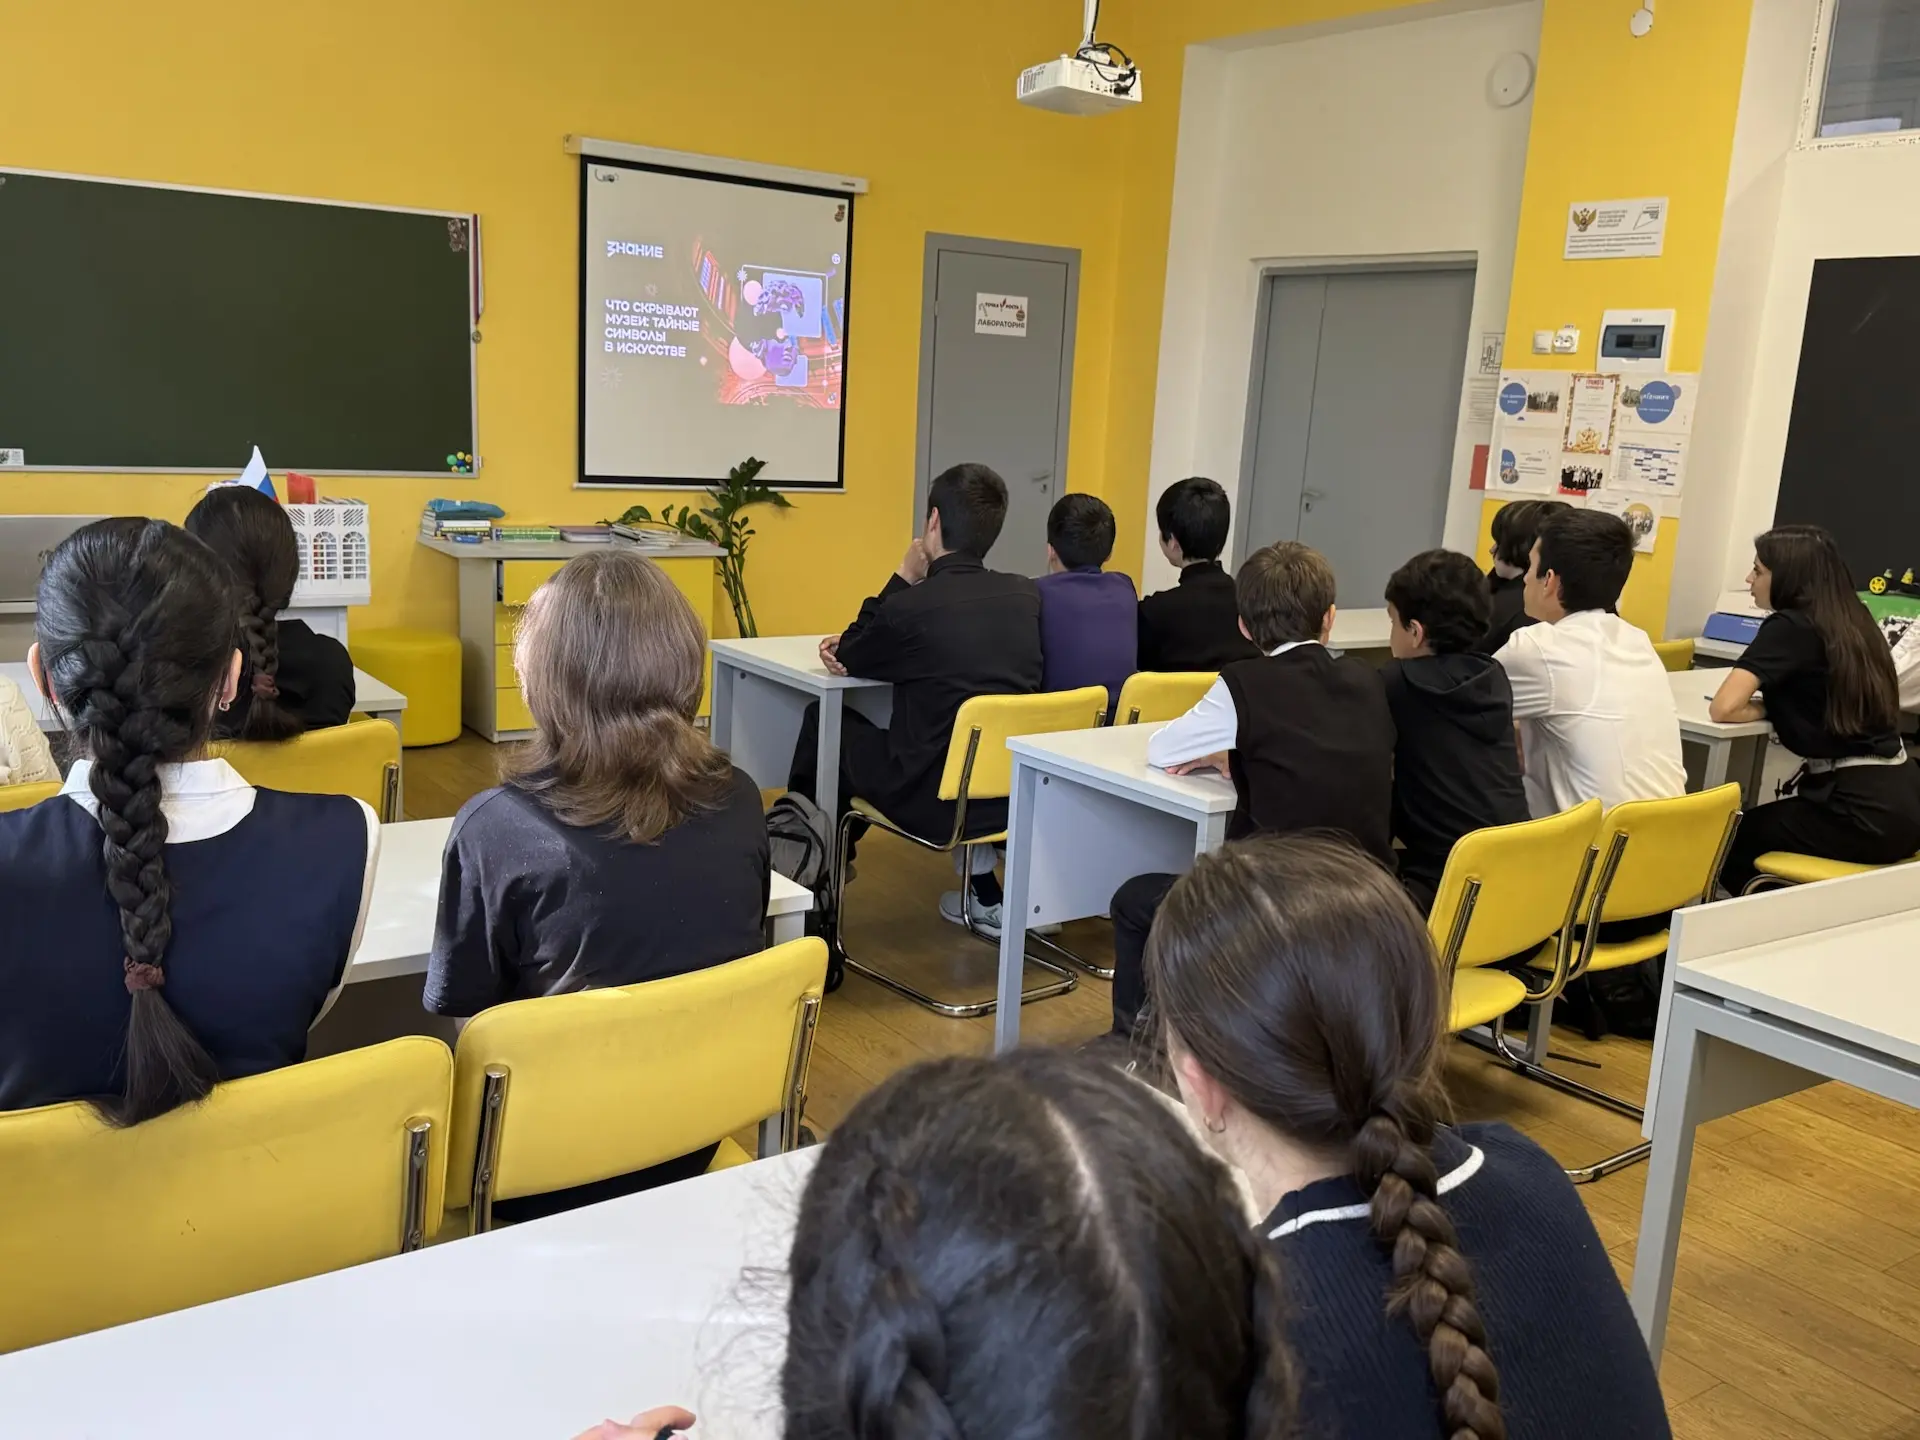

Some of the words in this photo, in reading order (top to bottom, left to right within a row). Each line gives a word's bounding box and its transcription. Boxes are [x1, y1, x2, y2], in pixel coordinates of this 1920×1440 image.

[607, 240, 664, 258] ЗНАНИЕ
[605, 299, 630, 311] ЧТО
[633, 302, 699, 318] СКРЫВАЮТ
[605, 313, 649, 327] МУЗЕИ:
[652, 316, 700, 332] ТАЙНЫЕ
[978, 319, 1025, 328] ЛАБОРАТОРИЯ
[605, 327, 666, 342] СИМВОЛЫ
[605, 341, 613, 352] В
[617, 342, 687, 357] ИСКУССТВЕ
